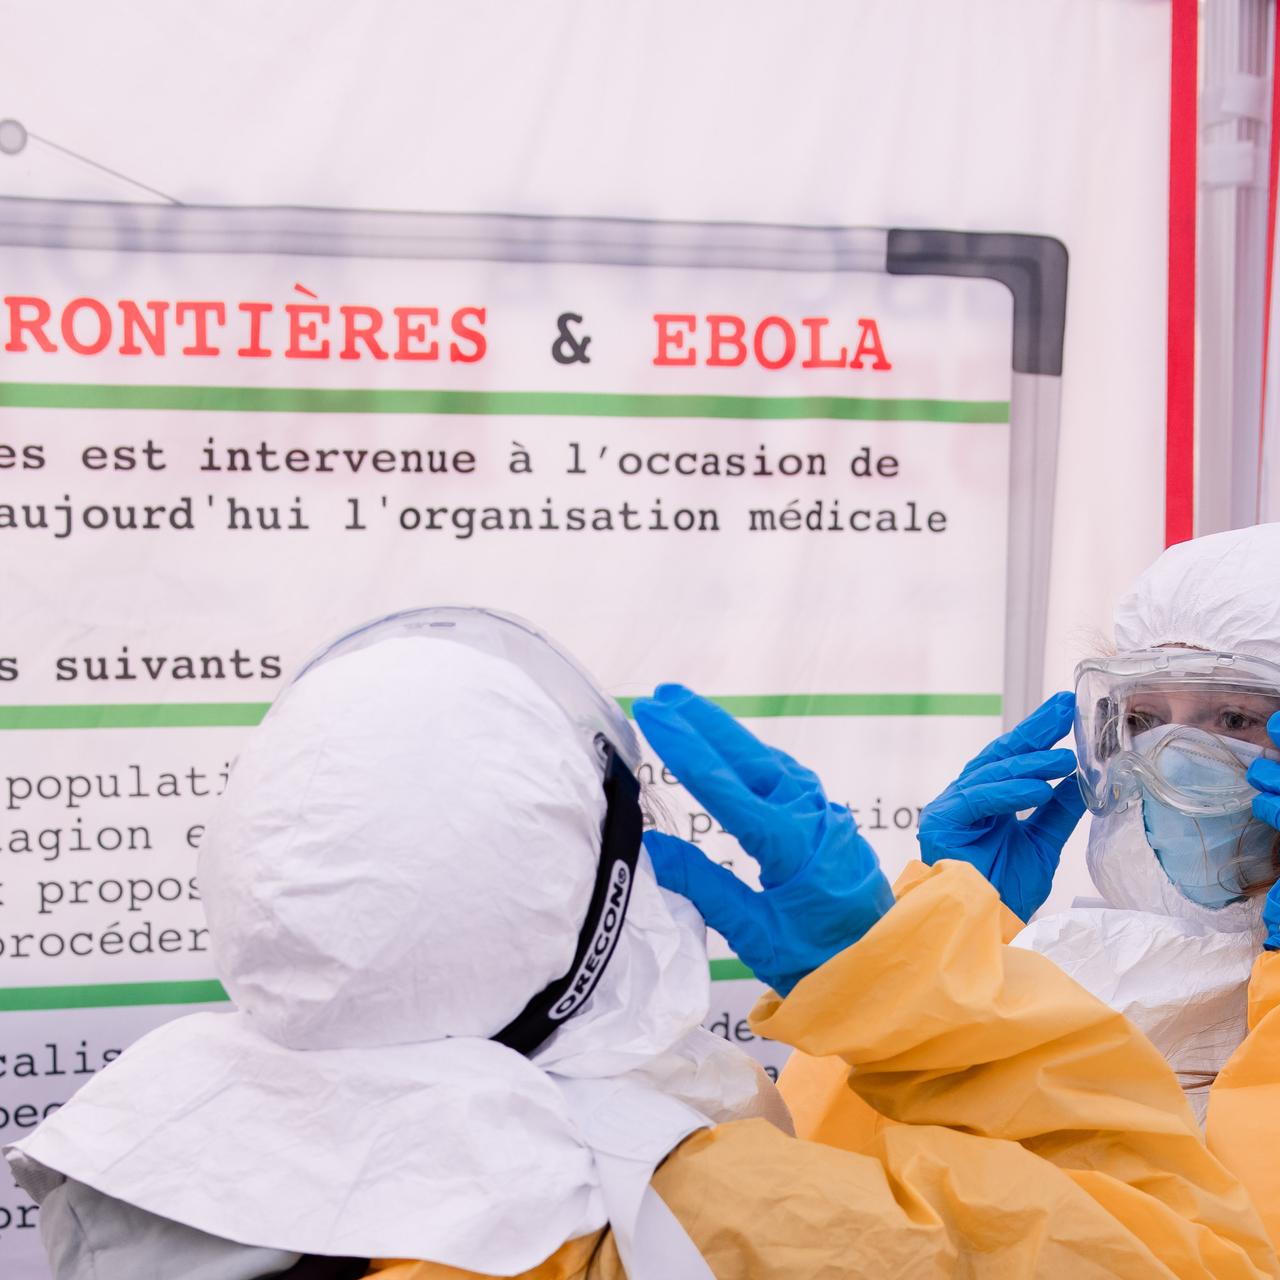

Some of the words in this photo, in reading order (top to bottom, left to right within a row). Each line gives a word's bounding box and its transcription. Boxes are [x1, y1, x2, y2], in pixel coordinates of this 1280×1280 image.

[552, 313, 591, 364] &
[652, 314, 893, 372] EBOLA
[82, 440, 166, 471] est
[201, 437, 475, 473] intervenue
[509, 442, 532, 473] à
[851, 447, 899, 477] de
[346, 496, 719, 539] l'organisation
[749, 500, 946, 532] médicale
[57, 646, 281, 681] suivants
